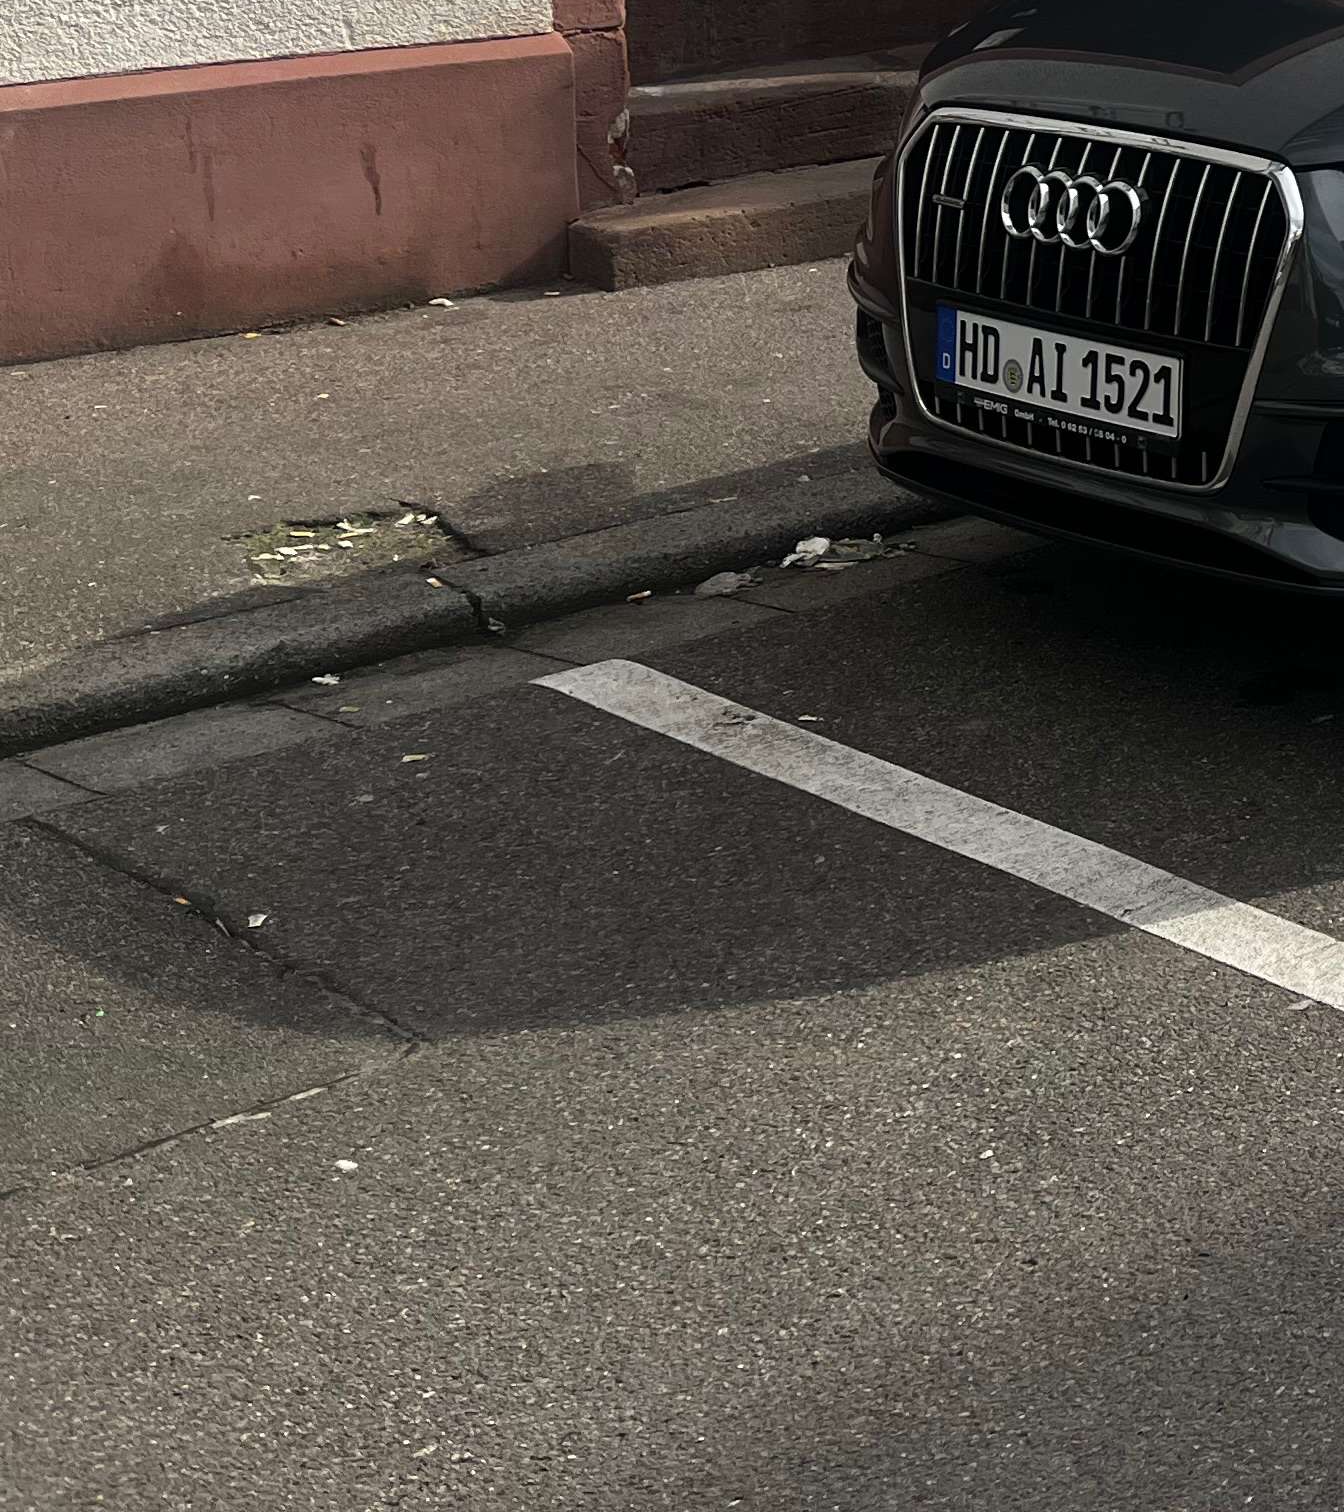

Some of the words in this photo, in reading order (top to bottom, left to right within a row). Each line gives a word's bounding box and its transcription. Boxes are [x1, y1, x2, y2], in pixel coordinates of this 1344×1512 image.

[943, 353, 950, 369] D
[959, 320, 1000, 384] HD
[1027, 338, 1068, 403] AI
[1080, 350, 1175, 427] 1521
